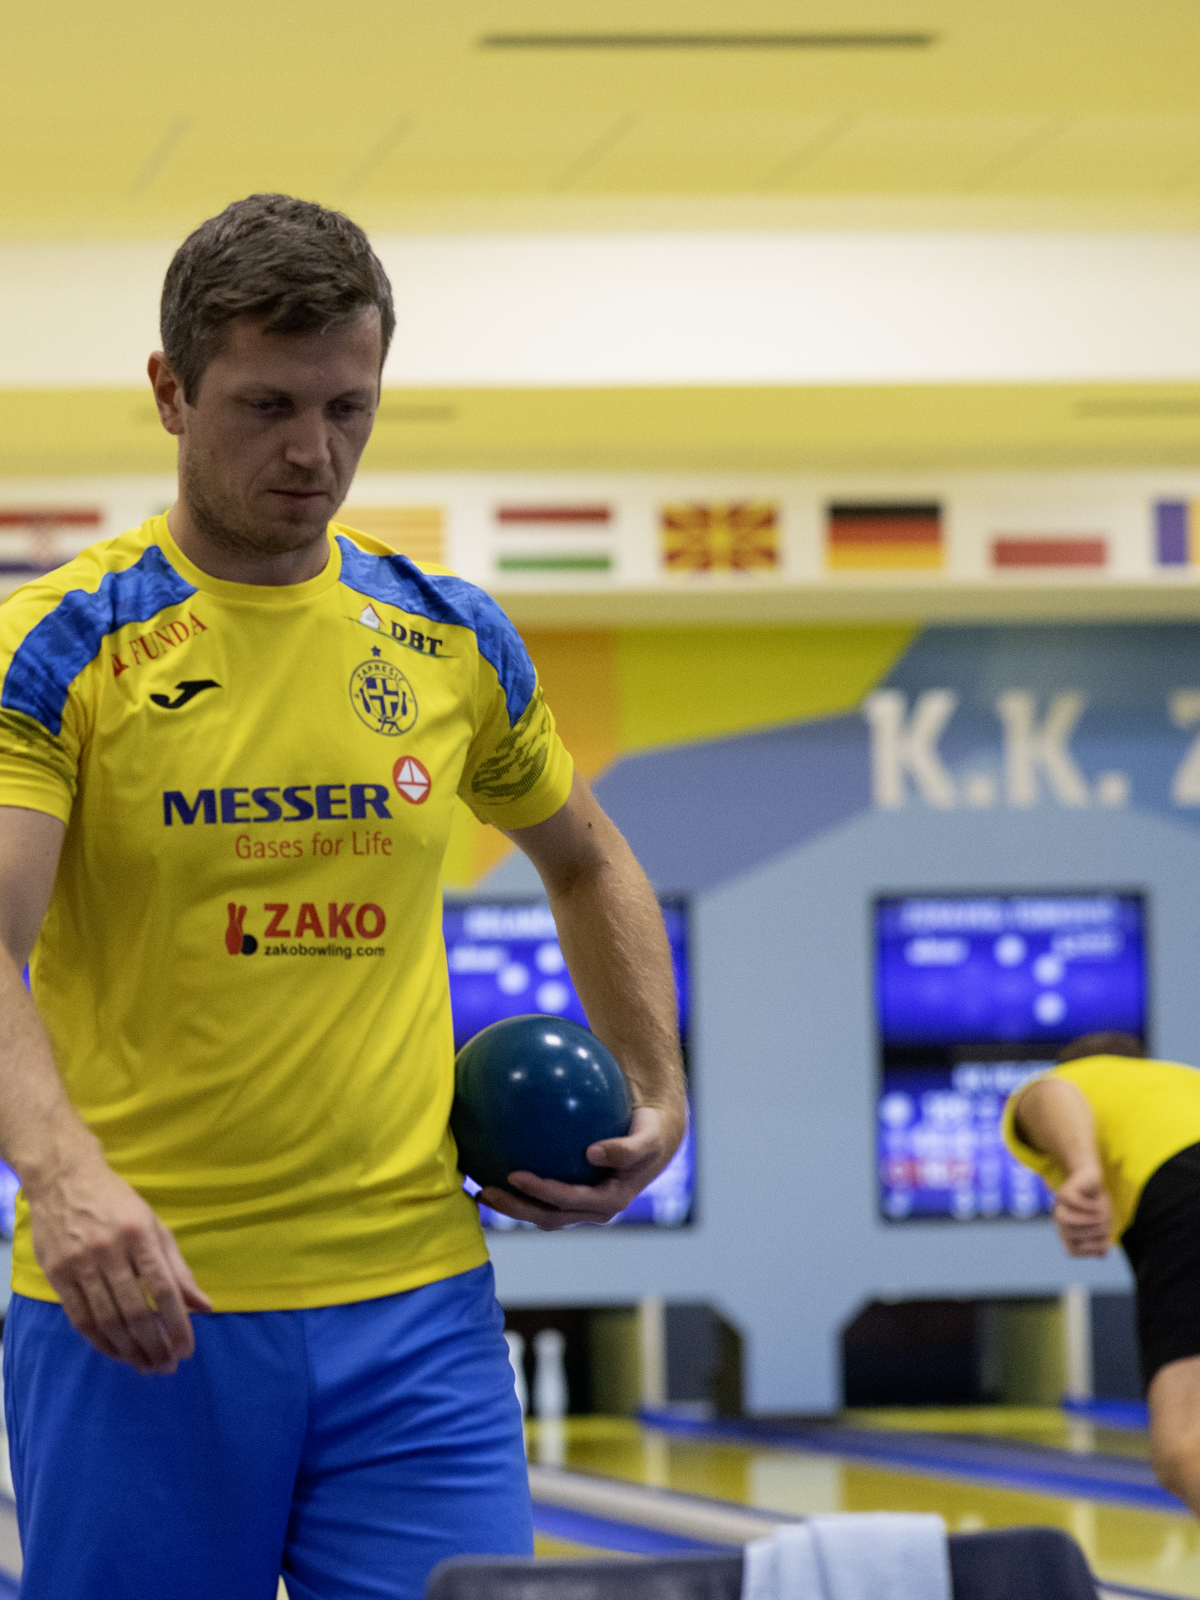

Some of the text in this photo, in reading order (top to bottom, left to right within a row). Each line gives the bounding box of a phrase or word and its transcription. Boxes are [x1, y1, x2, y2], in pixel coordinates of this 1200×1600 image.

[129, 611, 208, 665] FUNDA
[391, 621, 443, 656] DBT
[163, 784, 393, 826] MESSER
[235, 831, 392, 859] Gases for Life
[263, 903, 386, 939] ZAKO
[264, 944, 385, 959] zakobowling.com
